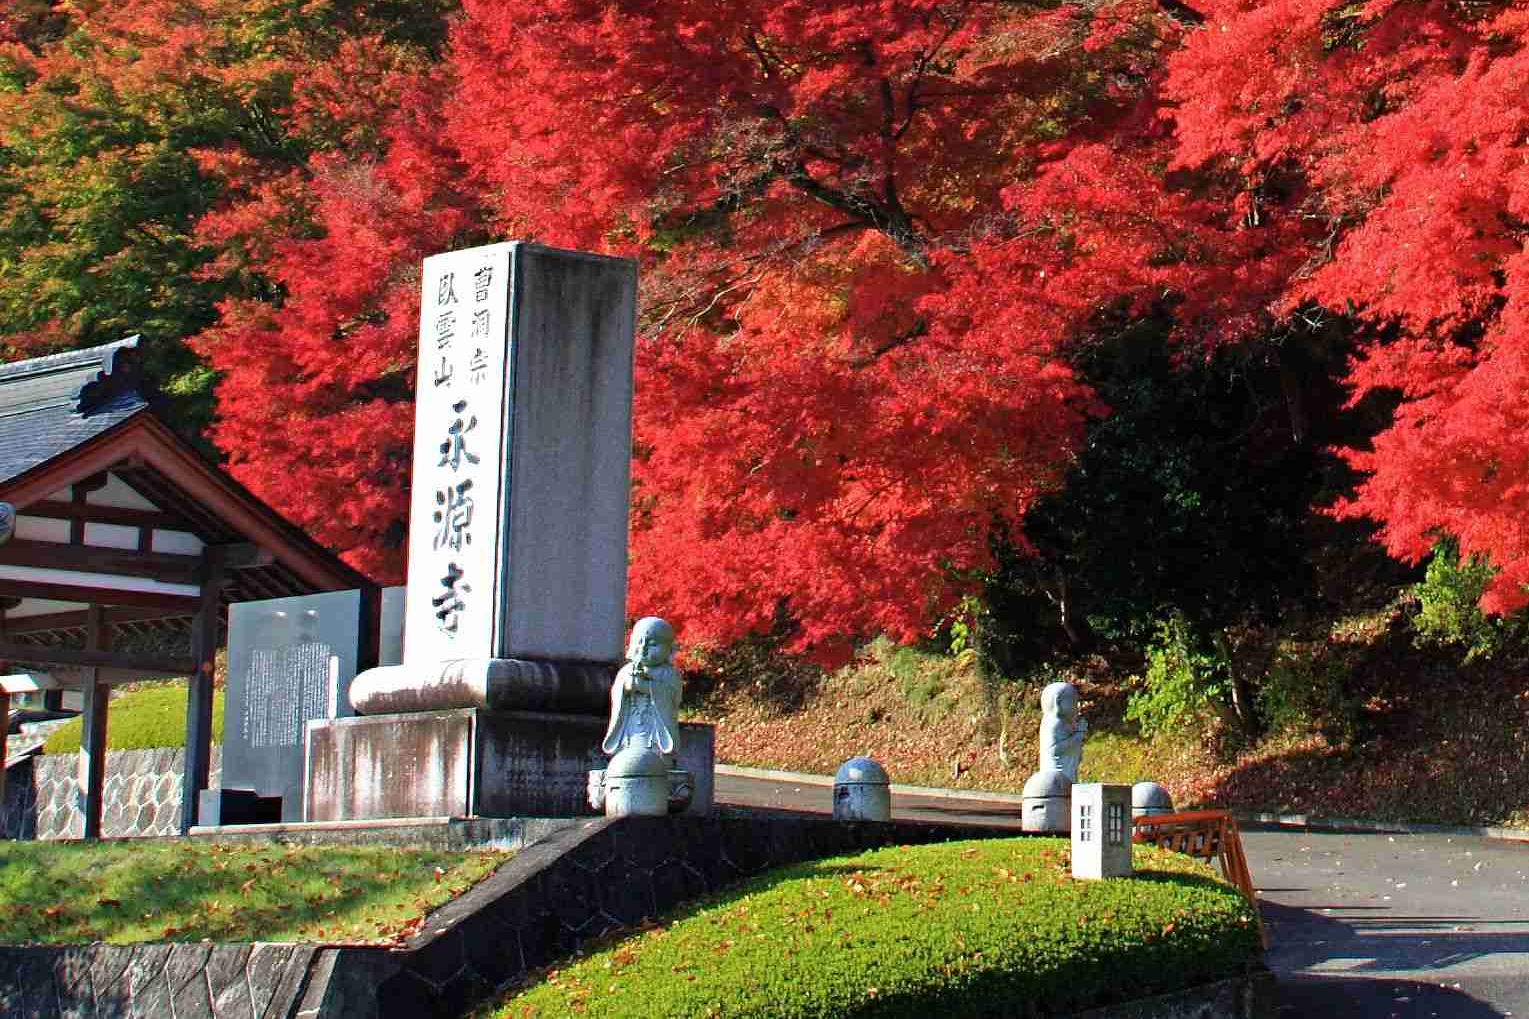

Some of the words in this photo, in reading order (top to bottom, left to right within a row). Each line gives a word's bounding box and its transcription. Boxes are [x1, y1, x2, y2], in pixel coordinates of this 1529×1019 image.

[434, 271, 459, 388] 臥雲山
[431, 399, 481, 639] 永源寺
